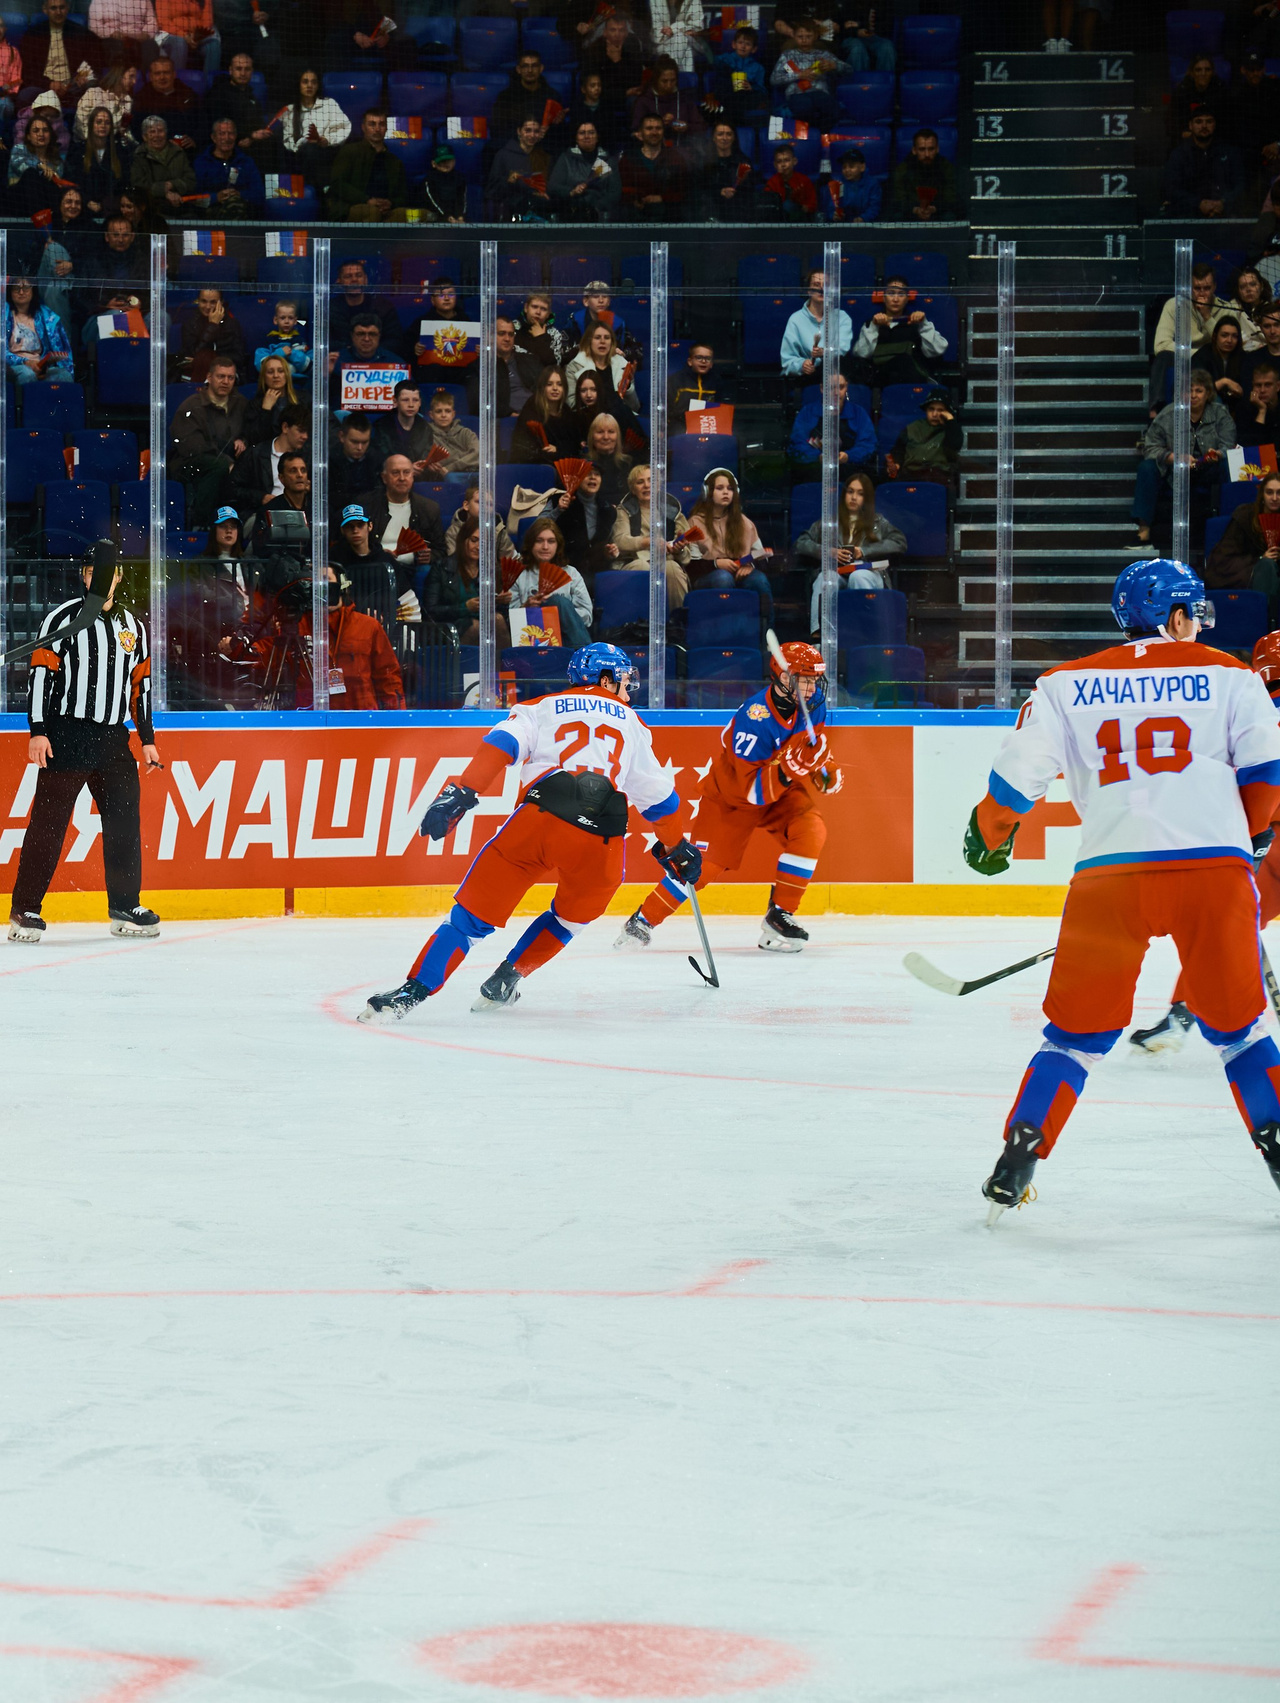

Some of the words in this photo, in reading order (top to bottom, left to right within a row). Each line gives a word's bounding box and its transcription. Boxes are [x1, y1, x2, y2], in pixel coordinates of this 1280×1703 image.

[982, 61, 1009, 82] 14
[1098, 58, 1125, 80] 14
[975, 115, 1004, 137] 13
[1100, 114, 1129, 136] 13
[973, 175, 1001, 198] 12
[1100, 174, 1128, 196] 12
[974, 234, 997, 256] 11
[1104, 234, 1127, 258] 11
[344, 385, 395, 401] ВПЕРЁ
[1073, 674, 1211, 706] ХАЧАТУРОВ
[555, 698, 627, 720] ВЕЩУНОВ
[554, 720, 625, 786] 23
[734, 731, 758, 757] 27
[1096, 716, 1193, 787] 10
